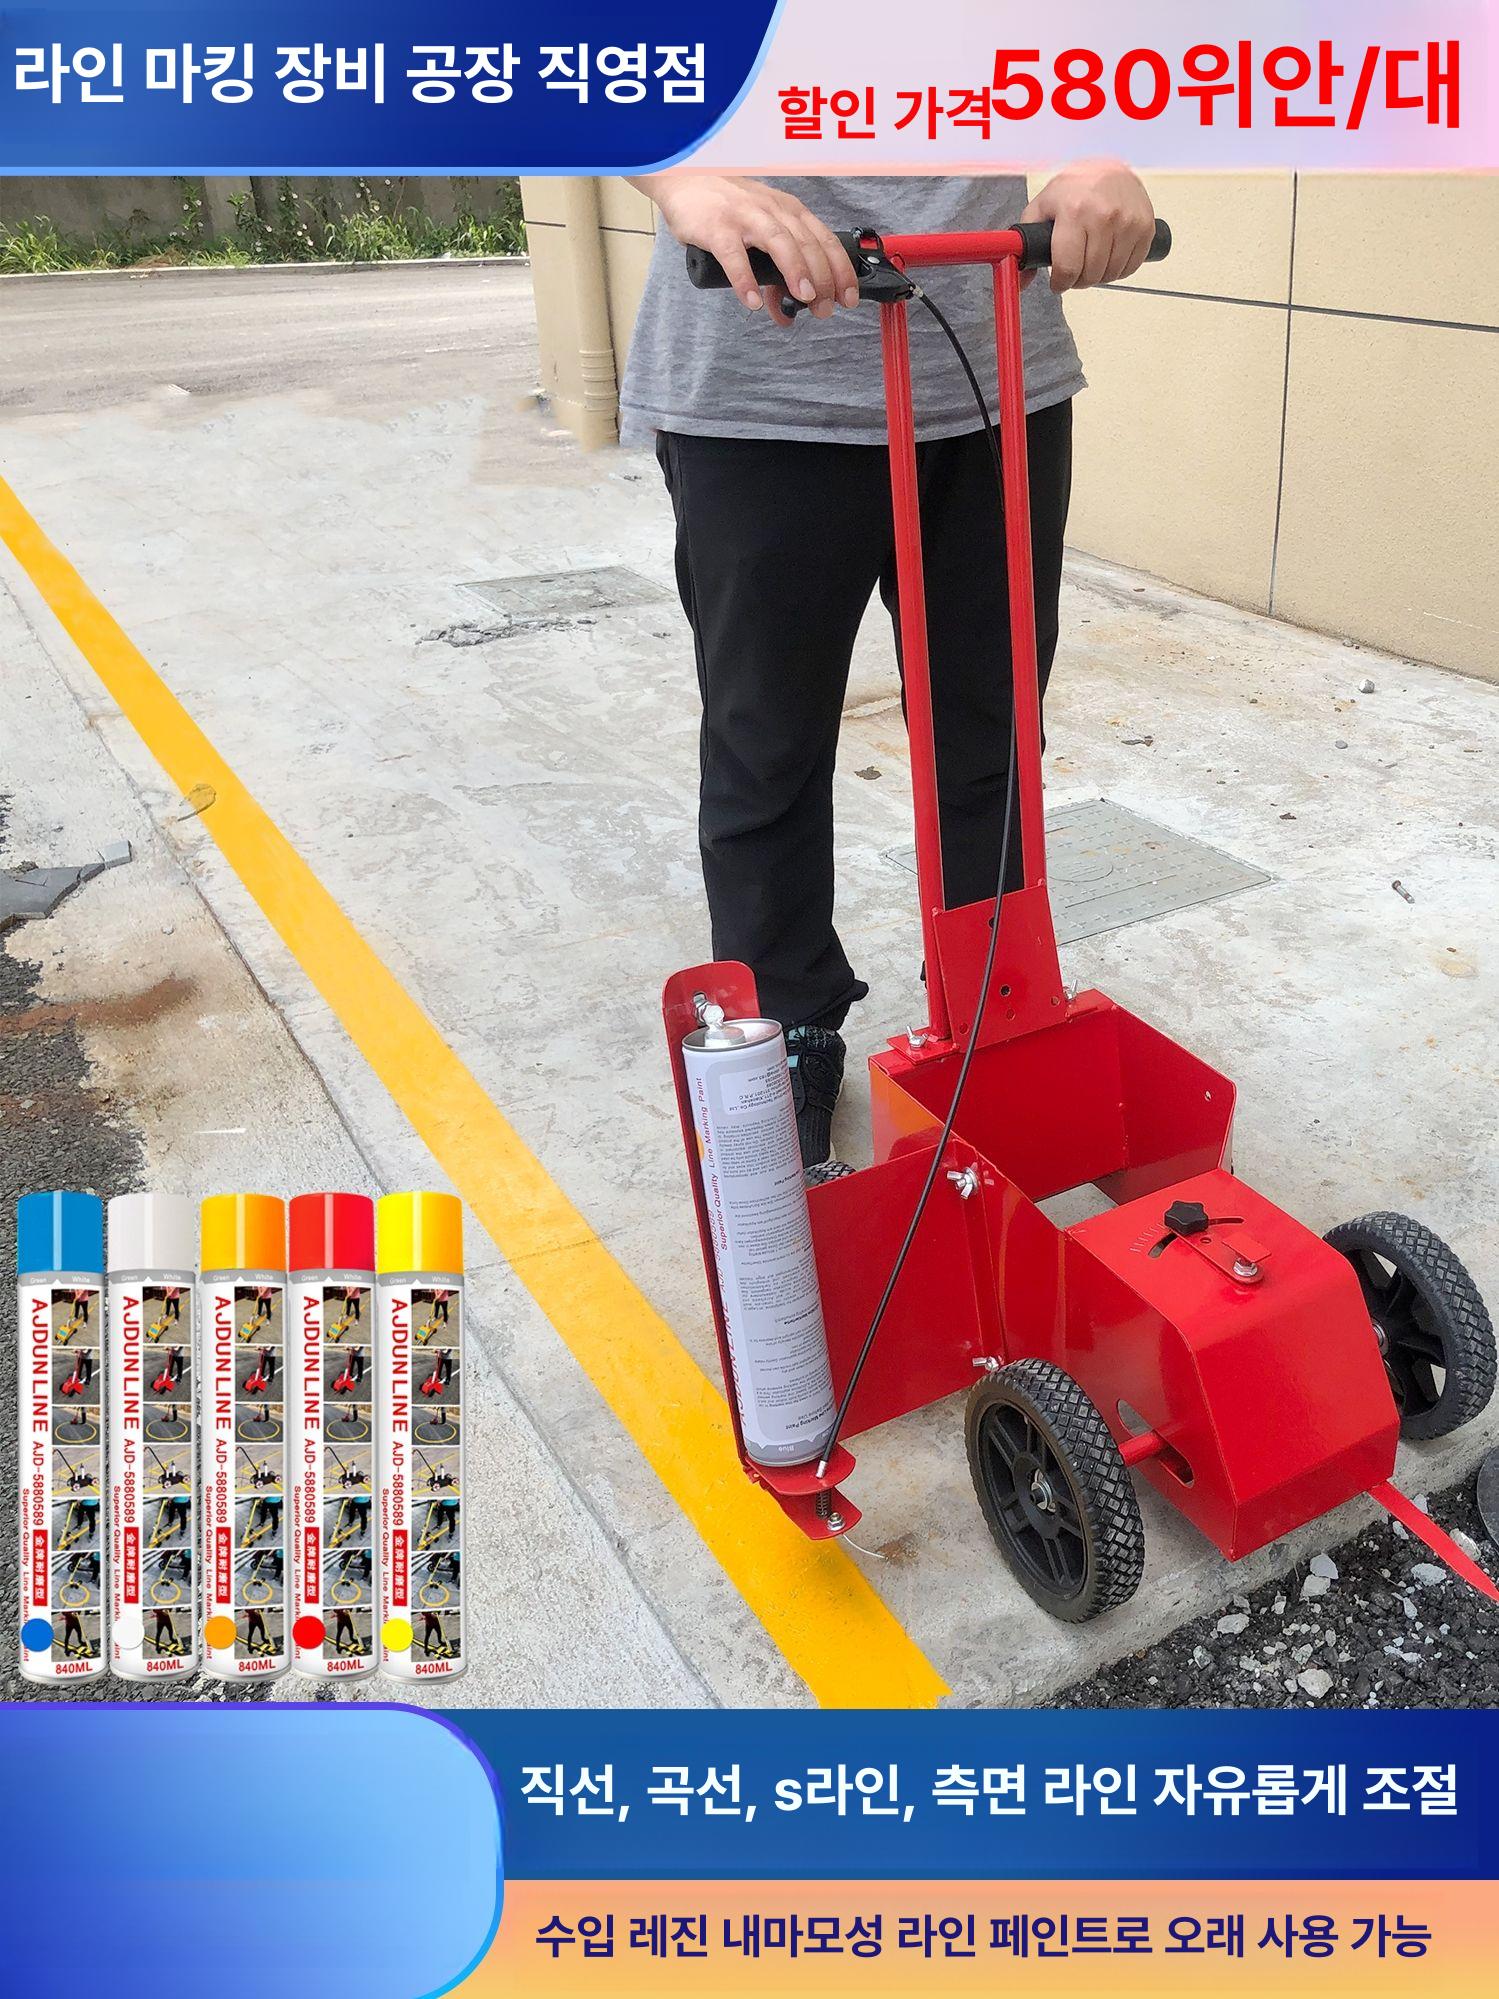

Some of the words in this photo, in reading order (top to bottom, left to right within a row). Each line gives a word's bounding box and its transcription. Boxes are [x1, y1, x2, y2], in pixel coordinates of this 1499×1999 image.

[697, 1078, 705, 1102] Paint
[700, 1107, 713, 1144] Marking
[708, 1149, 716, 1168] Line
[710, 1174, 722, 1208] Quality
[715, 1209, 728, 1250] Superior
[32, 1440, 44, 1526] AJD-5880589
[123, 1438, 135, 1524] AJD-5880589
[215, 1438, 227, 1524] AJD-5880589
[304, 1438, 316, 1524] AJD-5880589
[392, 1440, 404, 1526] AJD-5880589
[55, 1661, 93, 1675] 840ML
[146, 1658, 184, 1672] 840ML
[238, 1658, 276, 1672] 840ML
[326, 1658, 364, 1672] 840ML
[415, 1661, 453, 1675] 840ML
